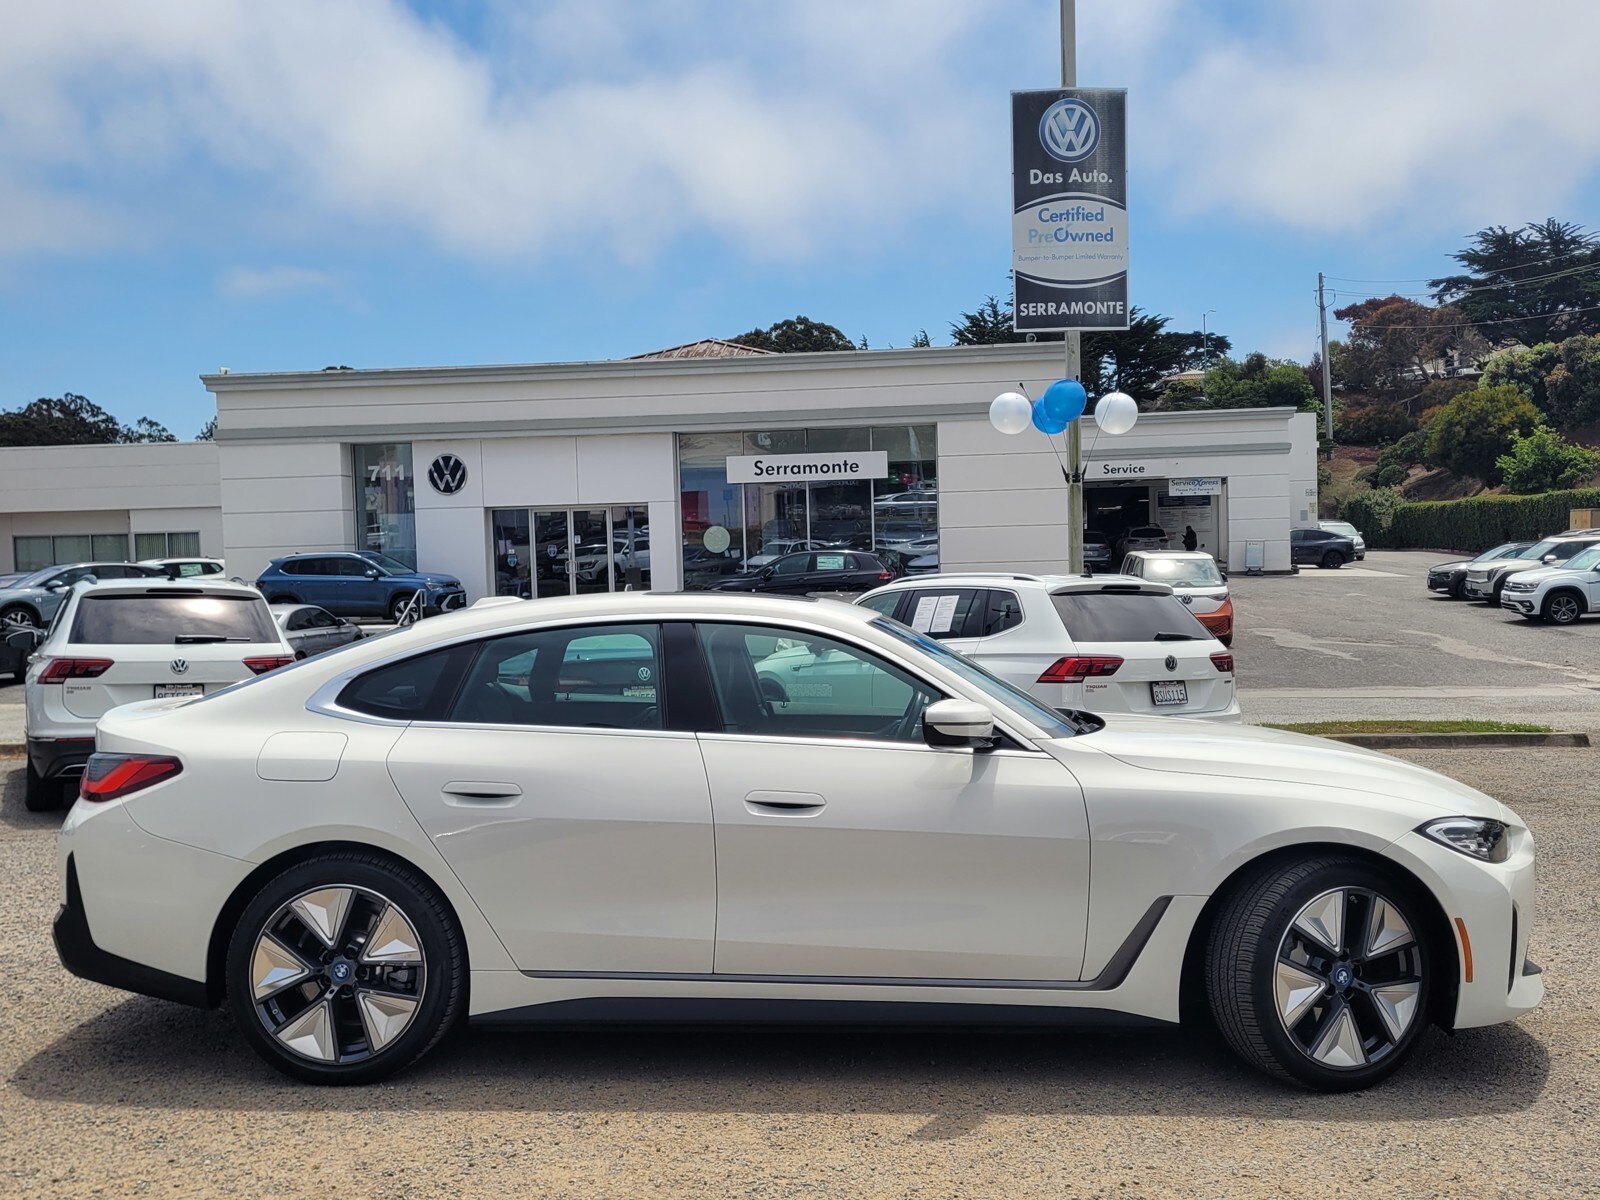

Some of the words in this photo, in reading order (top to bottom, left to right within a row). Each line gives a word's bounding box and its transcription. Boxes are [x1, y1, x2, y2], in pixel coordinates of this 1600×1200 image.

[1045, 103, 1095, 157] VW
[1029, 169, 1063, 184] Das
[1068, 167, 1113, 183] Auto.
[1038, 206, 1104, 223] Certified
[1097, 253, 1124, 261] Warranty
[1020, 301, 1124, 316] SERRAMONTE
[367, 464, 405, 481] 711
[430, 455, 467, 494] VW
[754, 460, 860, 477] Serramonte
[1103, 464, 1145, 475] Service
